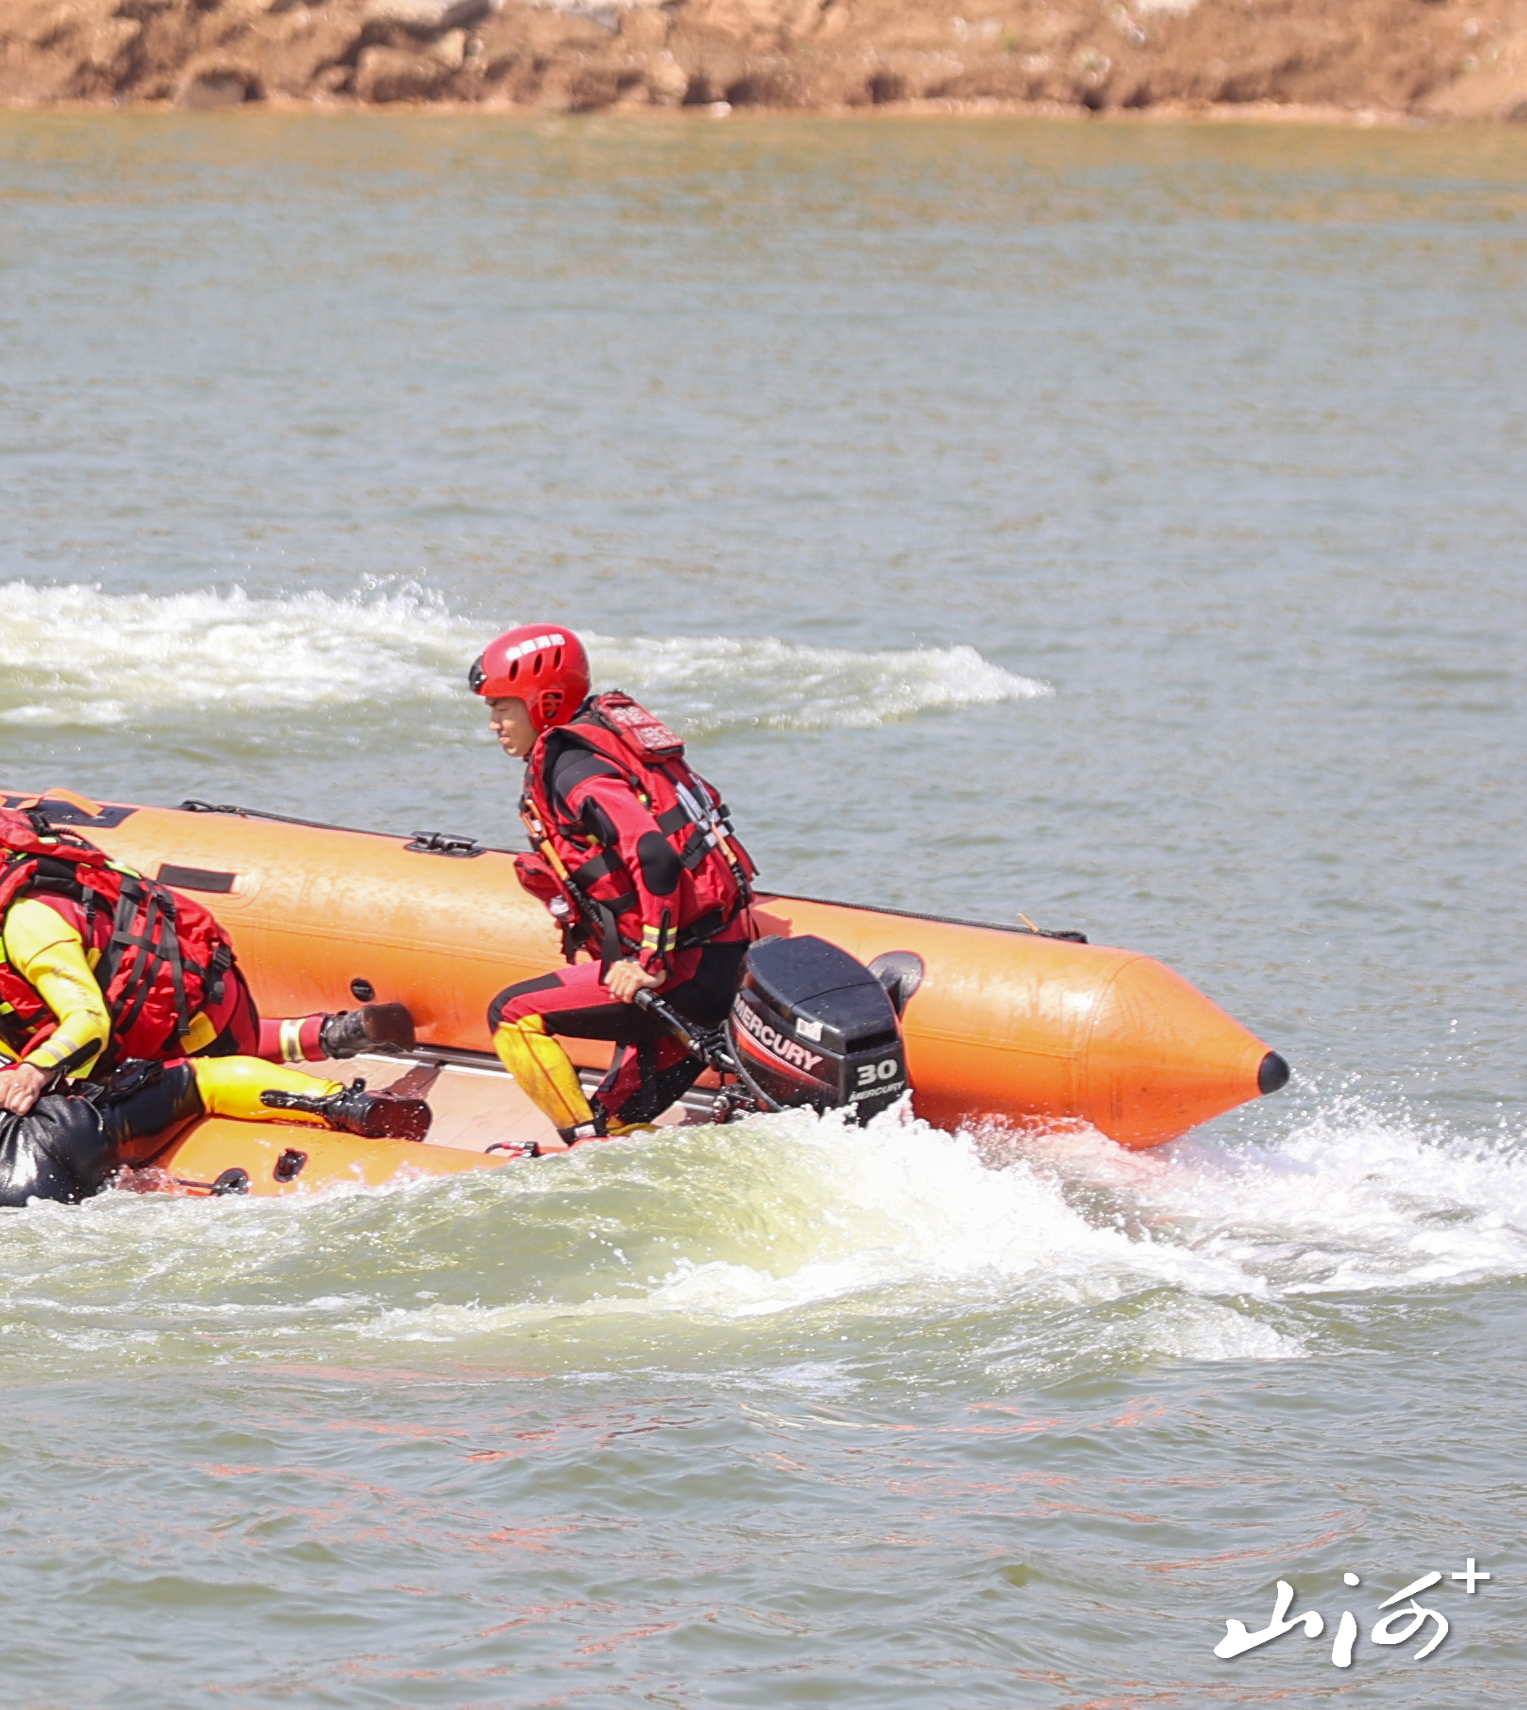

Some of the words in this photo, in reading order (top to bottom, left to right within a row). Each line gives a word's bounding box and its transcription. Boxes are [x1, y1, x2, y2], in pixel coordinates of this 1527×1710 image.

[733, 991, 824, 1071] MERCURY
[856, 1058, 898, 1086] 30
[847, 1080, 905, 1103] MERCURY
